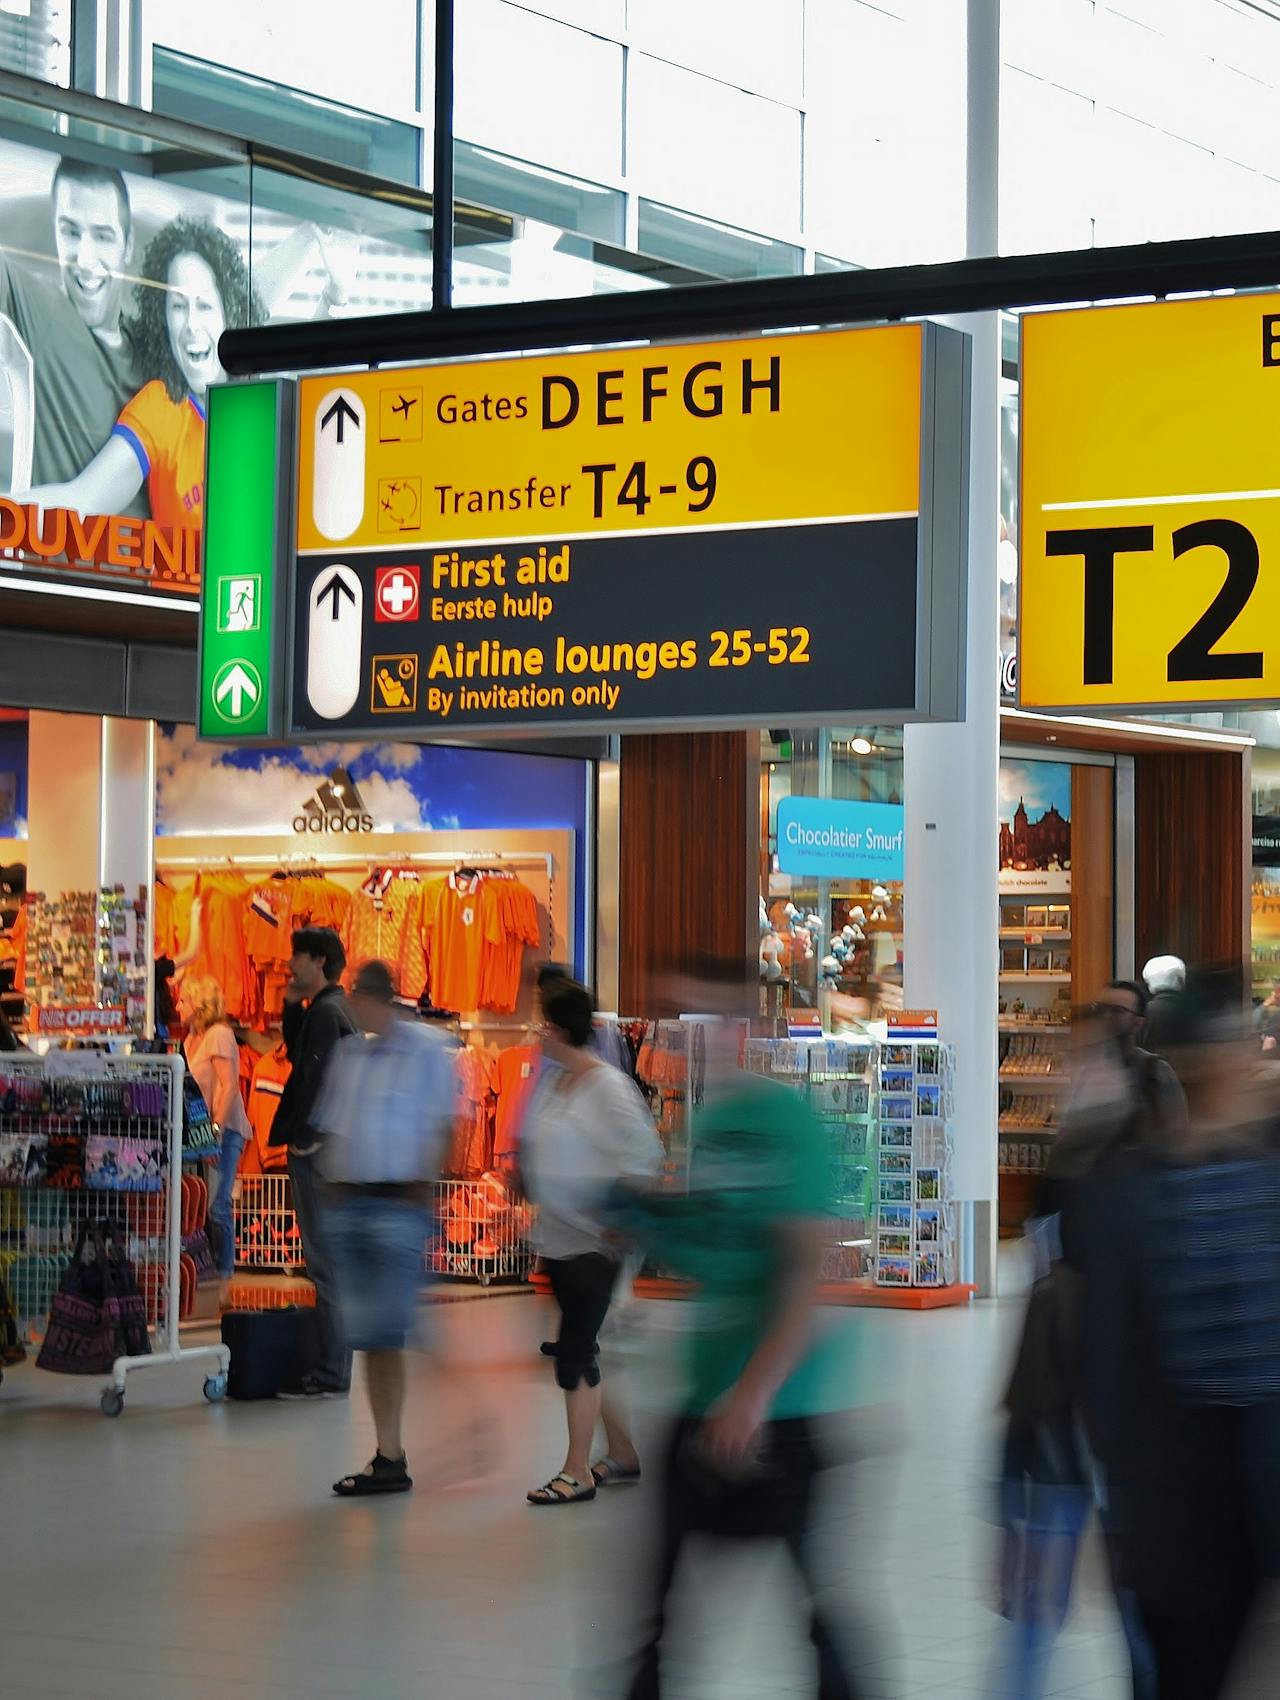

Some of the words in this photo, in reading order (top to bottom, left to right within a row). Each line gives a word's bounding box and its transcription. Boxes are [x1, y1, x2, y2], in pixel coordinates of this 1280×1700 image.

[436, 393, 529, 425] Gates
[434, 476, 572, 514] Transfer
[580, 455, 718, 519] T4-9
[431, 551, 507, 590] First
[516, 544, 571, 586] aid
[430, 595, 498, 622] Eerste
[502, 590, 554, 622] hulp
[427, 640, 545, 680] Airline
[555, 635, 698, 681] lounges
[707, 625, 811, 668] 25-52
[428, 686, 455, 718] By
[459, 682, 566, 711] invitation
[570, 678, 621, 711] only
[293, 813, 374, 833] adidas
[786, 821, 862, 849] Chocolatier
[865, 827, 903, 851] Smurf
[66, 1009, 122, 1028] OFFER
